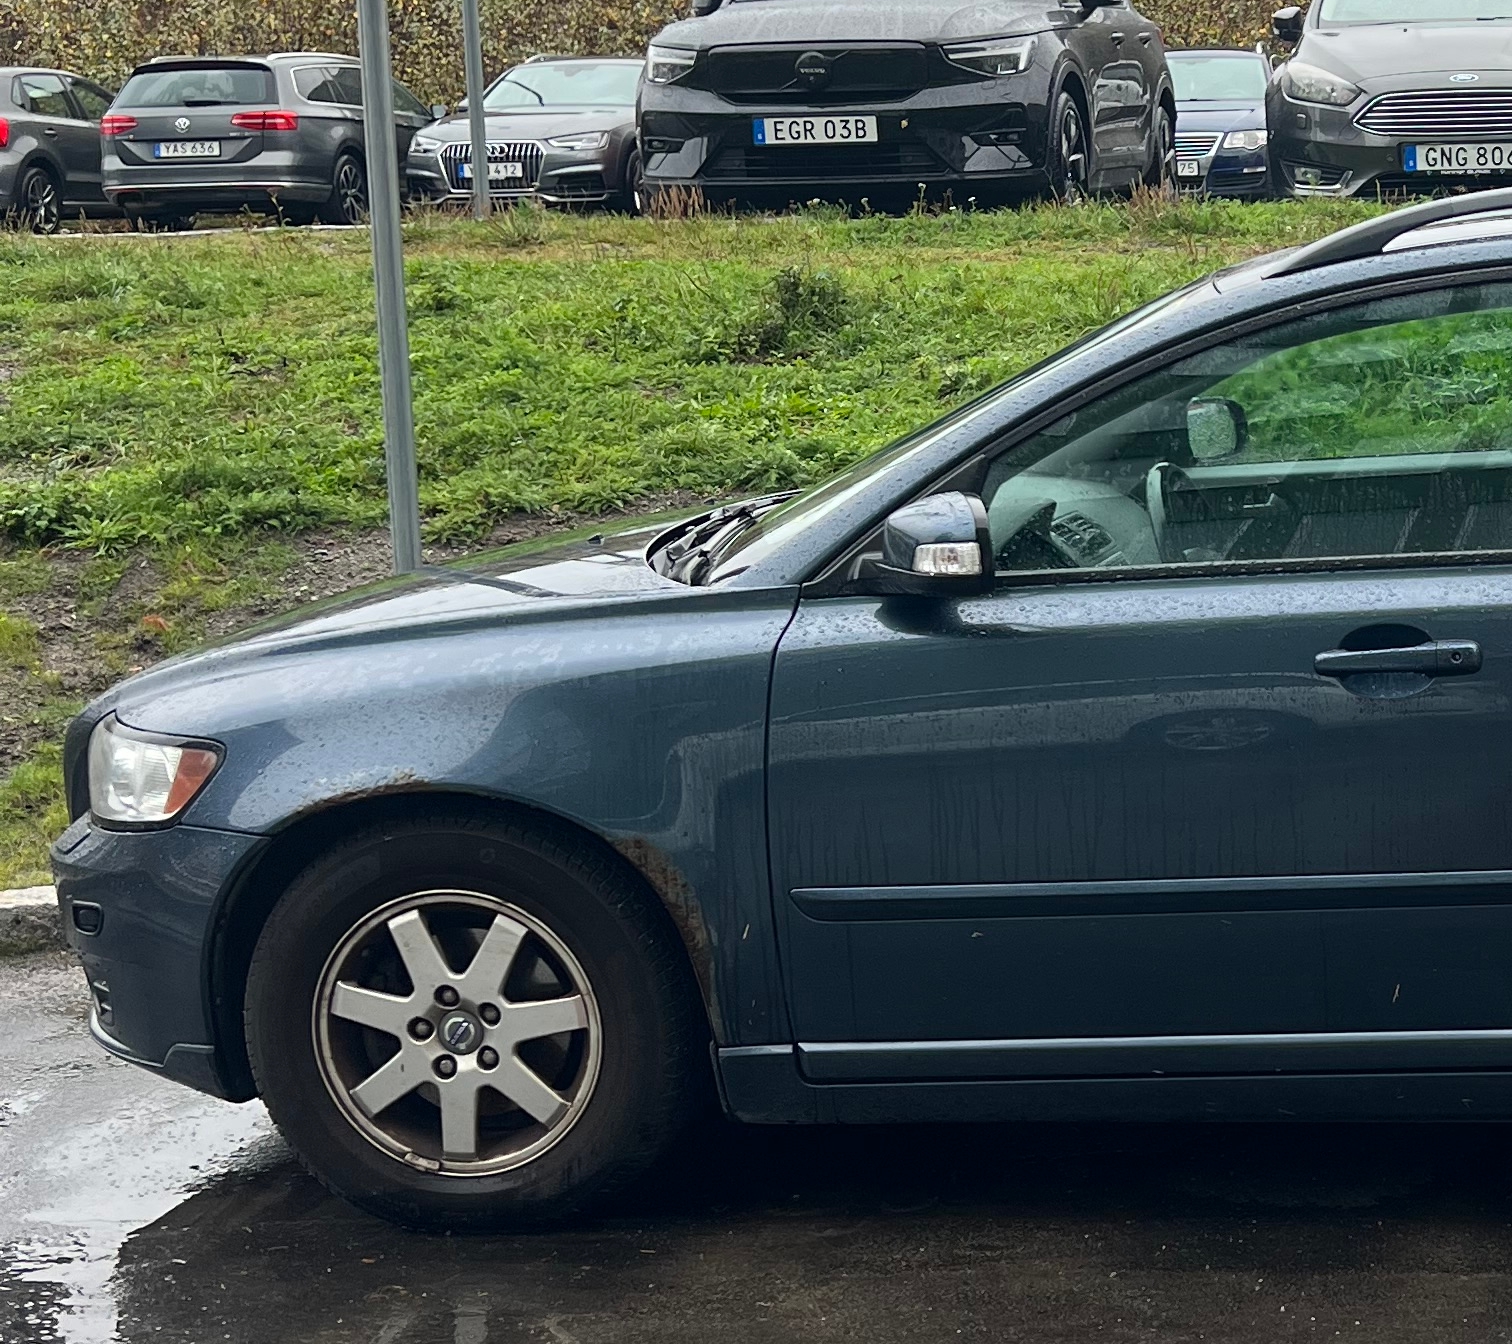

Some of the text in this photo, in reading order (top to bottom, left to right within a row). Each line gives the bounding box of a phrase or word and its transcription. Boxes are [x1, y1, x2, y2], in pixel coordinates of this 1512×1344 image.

[773, 118, 867, 141] EGR 03B
[163, 142, 215, 155] YAS 636
[1425, 146, 1468, 168] GNG
[493, 163, 517, 175] 412
[1179, 162, 1196, 174] 75
